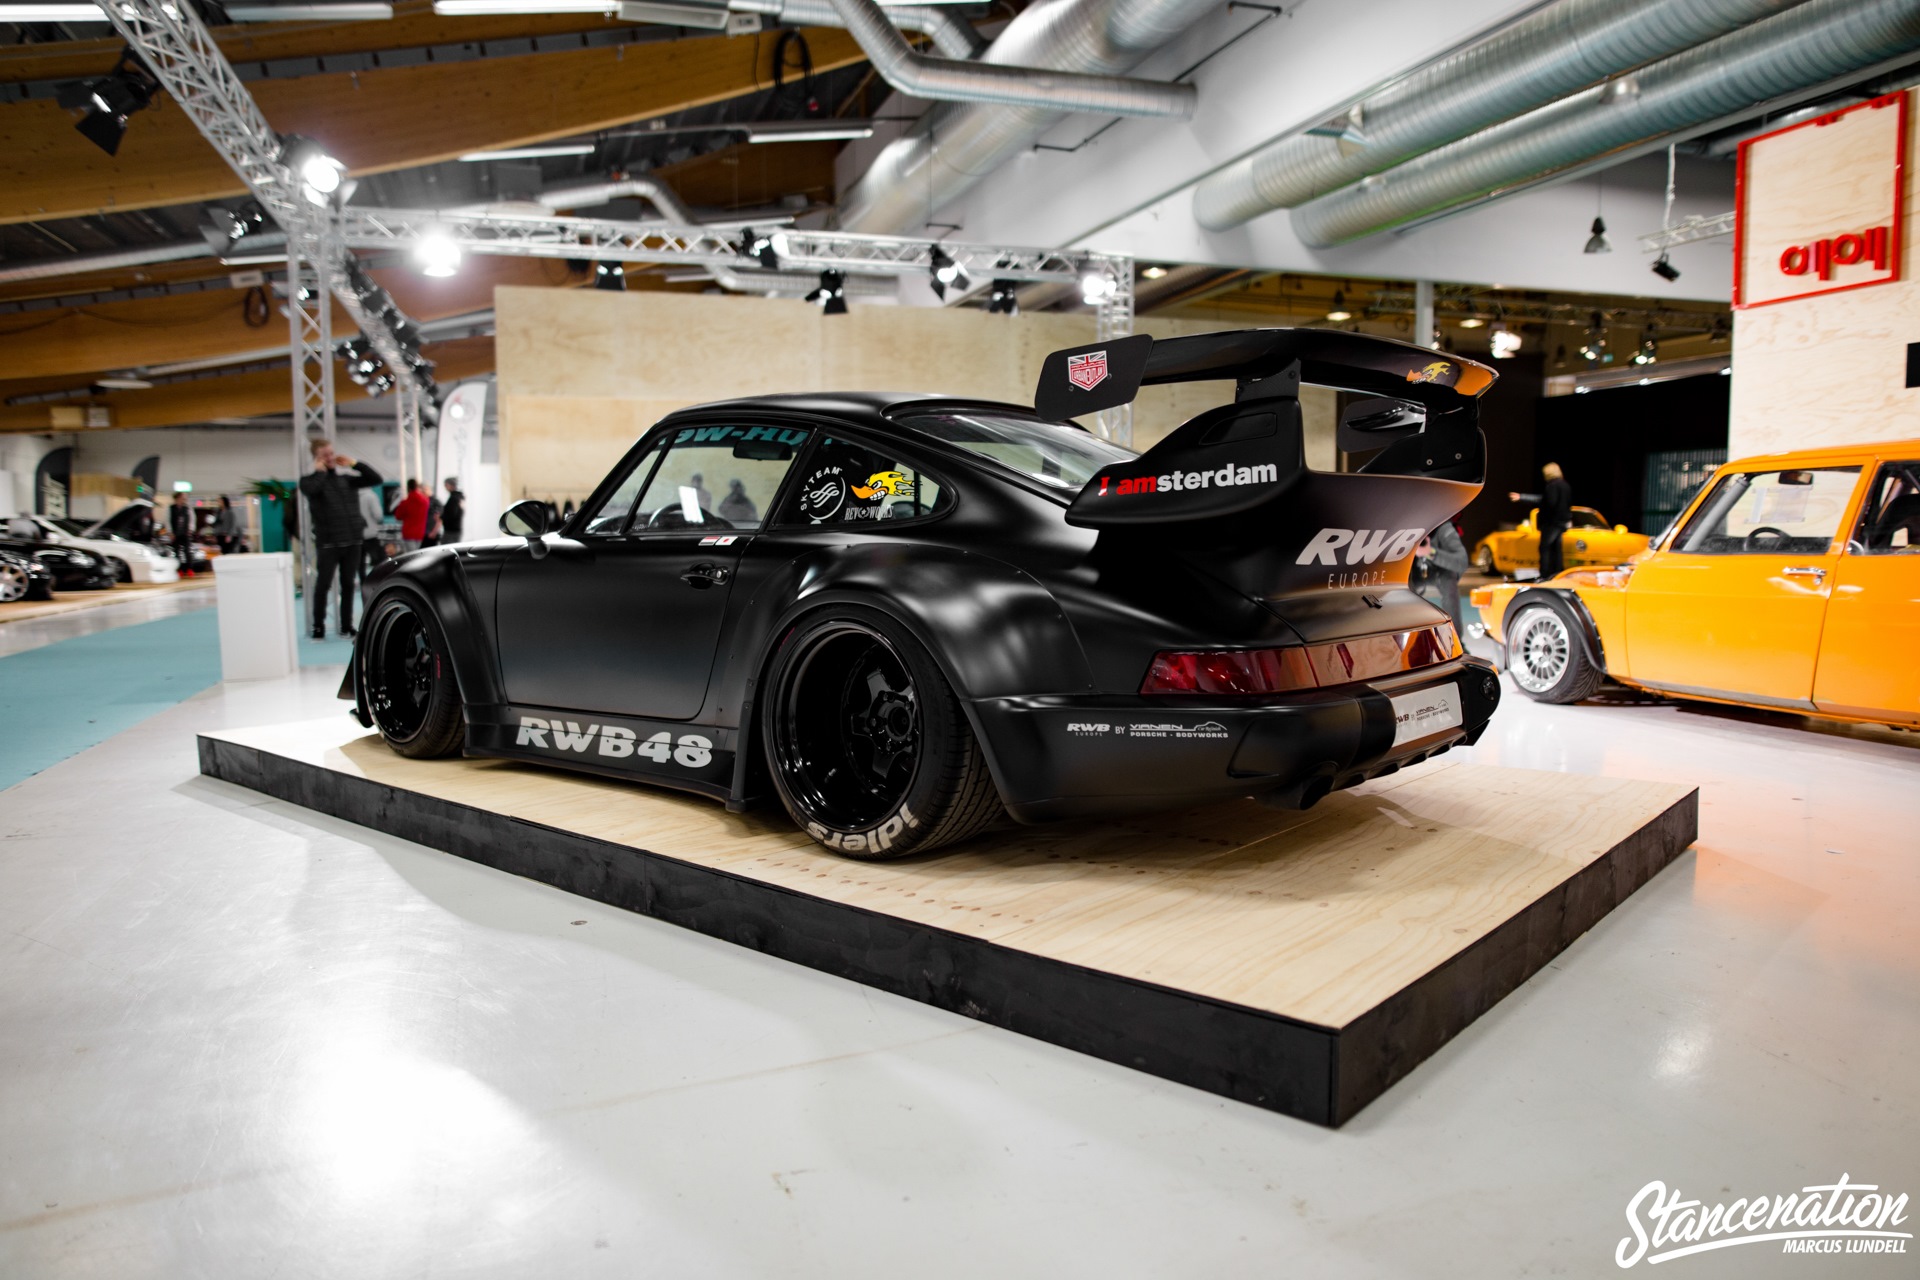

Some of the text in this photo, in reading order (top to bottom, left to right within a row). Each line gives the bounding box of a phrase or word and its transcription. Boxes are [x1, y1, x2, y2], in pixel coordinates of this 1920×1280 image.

[1098, 462, 1278, 497] I amsterdam
[1295, 528, 1425, 566] RWB
[1327, 570, 1387, 589] EUROPE
[515, 715, 713, 769] RWB48
[1066, 723, 1111, 732] RWB
[1114, 726, 1126, 735] BY
[806, 801, 919, 854] idlers
